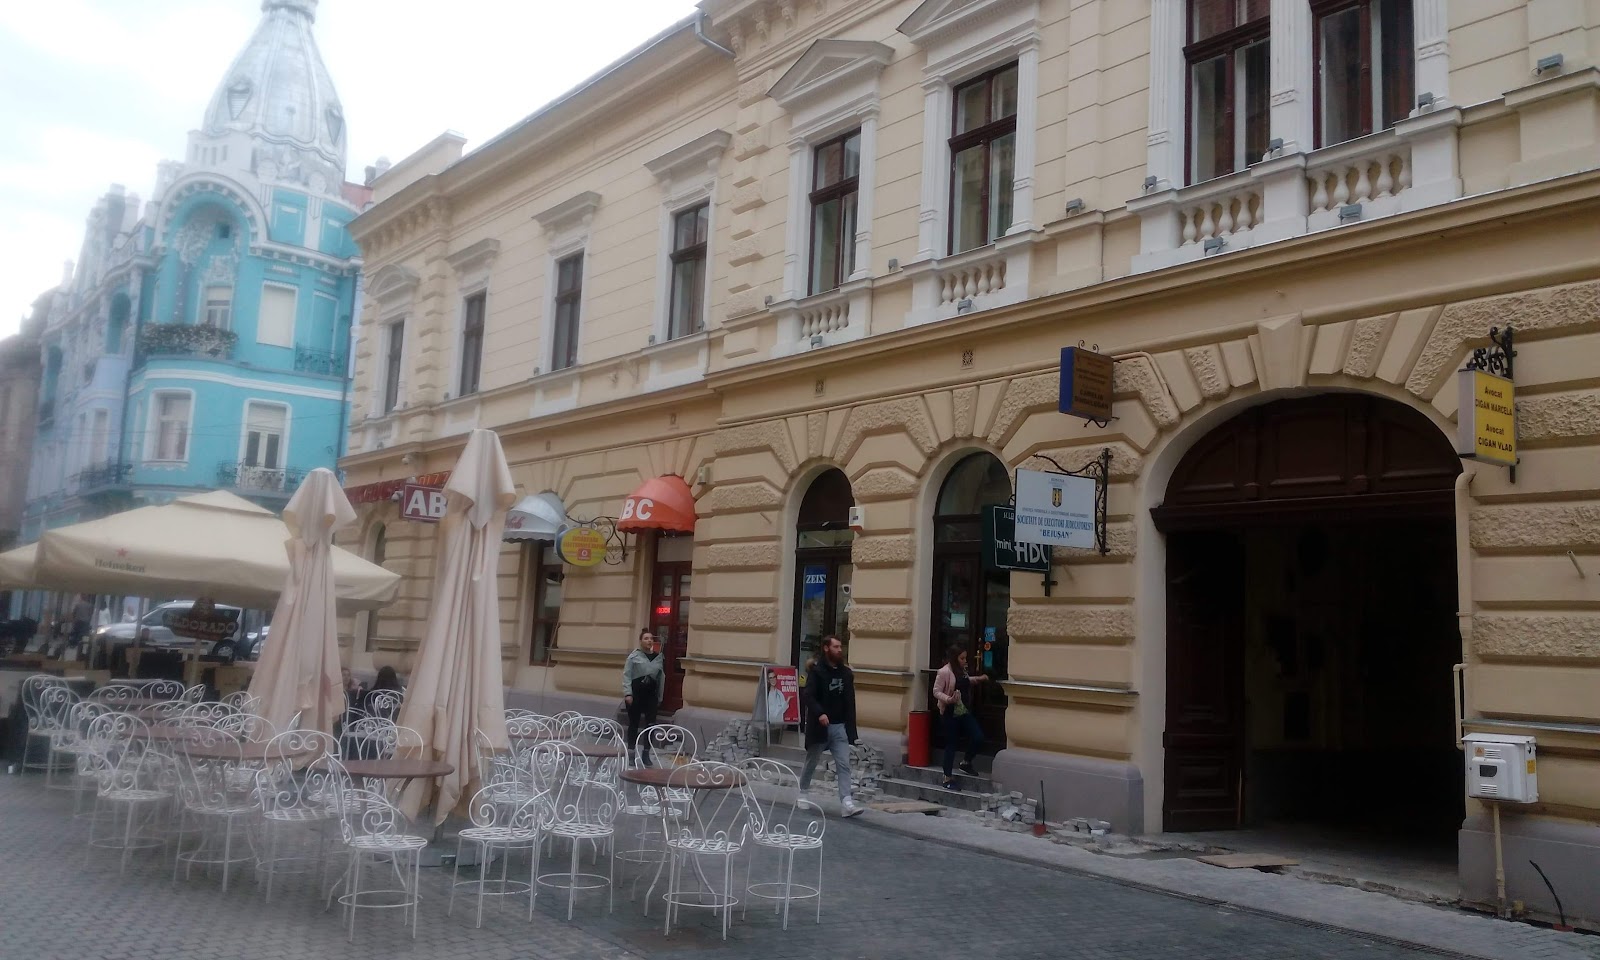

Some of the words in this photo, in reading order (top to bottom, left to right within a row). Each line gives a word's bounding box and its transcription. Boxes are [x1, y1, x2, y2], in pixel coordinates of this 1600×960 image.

[1485, 386, 1503, 399] Avocat
[1491, 403, 1513, 416] MARCELA
[1486, 423, 1505, 436] Avocat
[1497, 441, 1513, 452] VLAD
[620, 498, 654, 521] BC
[1016, 514, 1038, 526] SOCIETATE
[996, 538, 1014, 552] mini
[94, 558, 145, 573] Heineken
